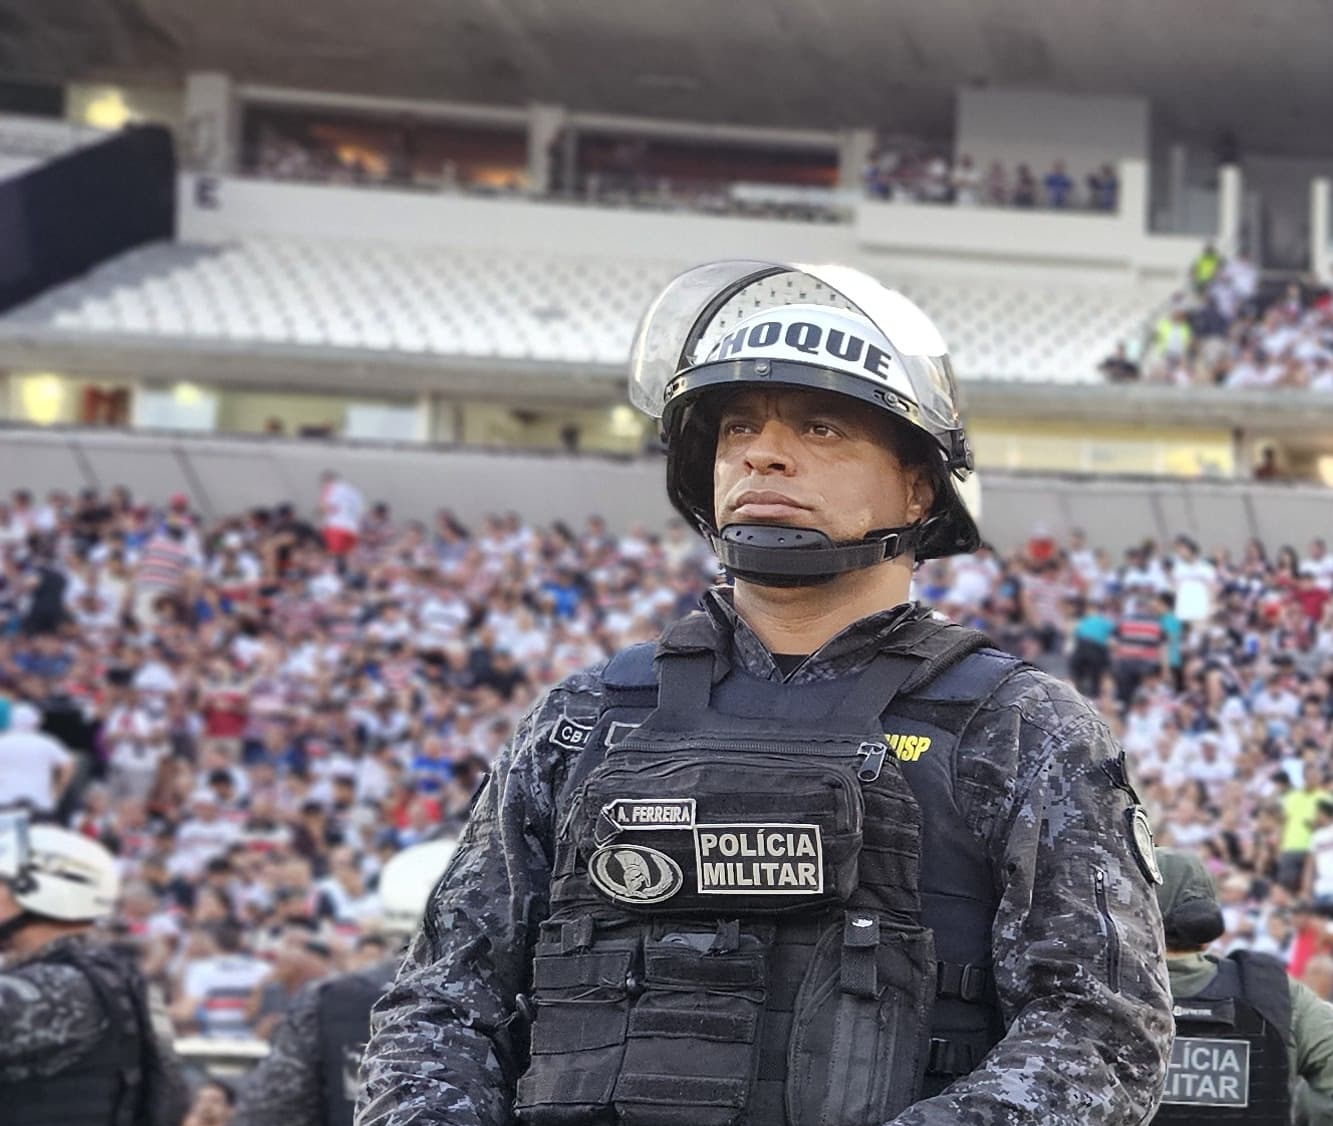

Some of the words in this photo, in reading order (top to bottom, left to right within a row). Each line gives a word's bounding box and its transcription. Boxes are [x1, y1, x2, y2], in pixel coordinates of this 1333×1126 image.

[884, 734, 932, 761] USP
[618, 806, 630, 822] A.
[632, 806, 690, 822] FERREIRA
[701, 829, 817, 857] POLÍCIA
[703, 863, 817, 886] MILITAR
[1163, 1073, 1240, 1099] ITAR
